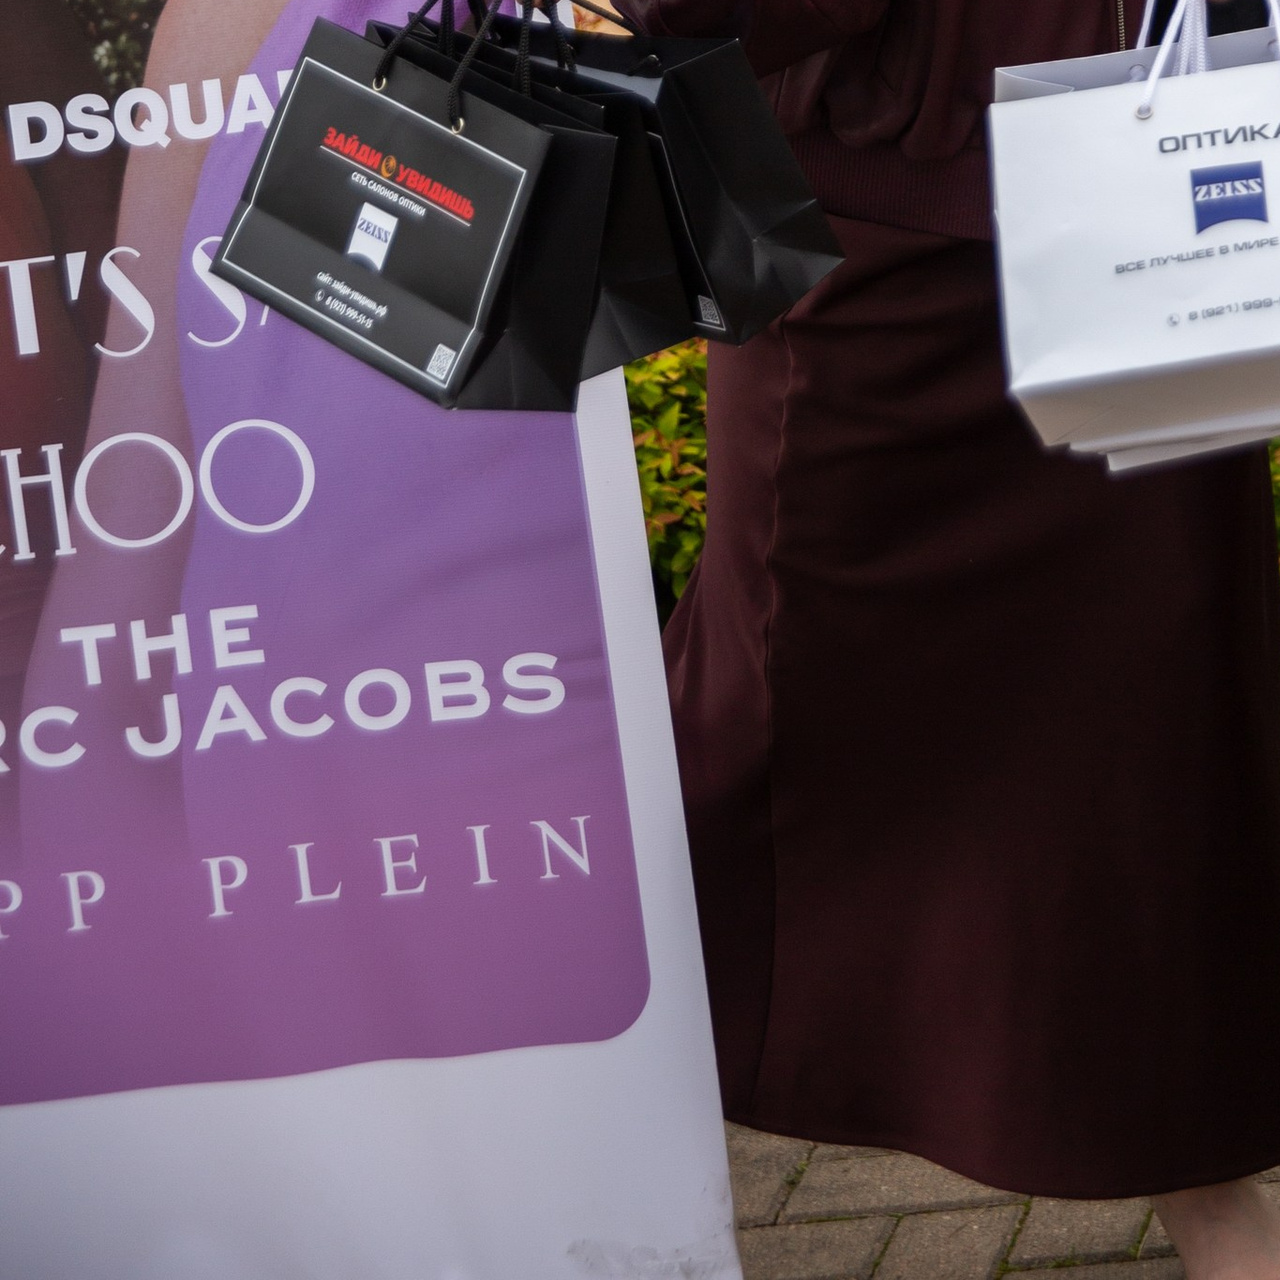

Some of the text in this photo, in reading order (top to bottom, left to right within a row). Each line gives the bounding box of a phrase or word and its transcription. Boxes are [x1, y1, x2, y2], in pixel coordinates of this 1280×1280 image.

[322, 126, 475, 221] ЗАЙДИ УВИДИШЬ
[351, 171, 427, 216] СЕТЬ САЛОНОВ ОПТИКИ
[1194, 178, 1263, 201] ZEISS
[357, 218, 391, 243] ZEISS
[1114, 260, 1145, 274] ВСЕ
[1150, 247, 1215, 268] ЛУЧШЕЕ
[1219, 245, 1229, 255] В
[1234, 237, 1279, 252] МИРЕ
[187, 235, 270, 347] S
[330, 298, 347, 315] (921)
[1188, 311, 1198, 320] 8
[1202, 303, 1239, 319] (921)
[0, 419, 315, 560] HOO
[60, 604, 266, 686] THE
[0, 651, 567, 773] C JACOBS
[202, 814, 593, 918] PLEIN
